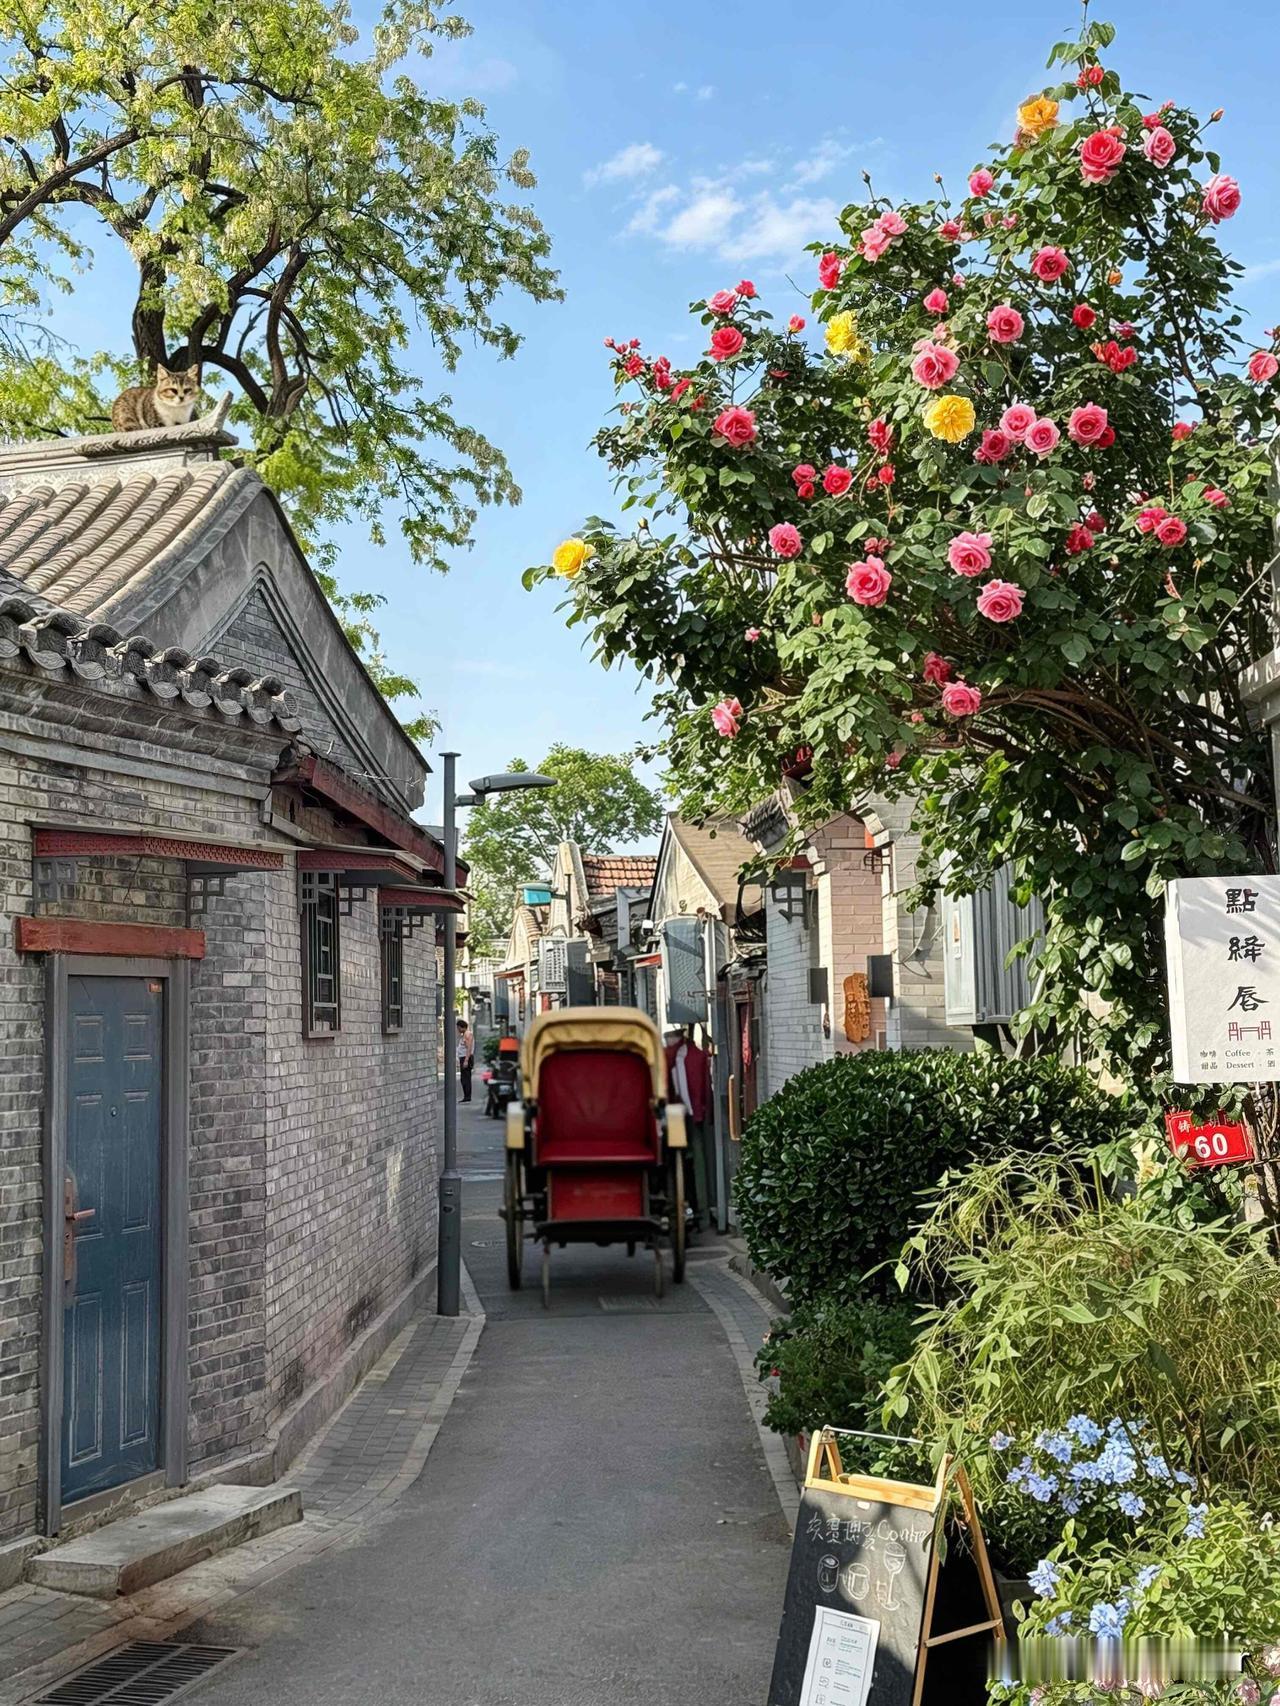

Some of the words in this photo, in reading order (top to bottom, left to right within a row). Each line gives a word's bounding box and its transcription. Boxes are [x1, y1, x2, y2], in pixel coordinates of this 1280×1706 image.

[1225, 888, 1270, 1012] 點絳唇
[1225, 1049, 1251, 1057] Coffee
[1266, 1047, 1275, 1056] 茶
[1226, 1061, 1254, 1069] Dessert
[1194, 1133, 1228, 1159] 60
